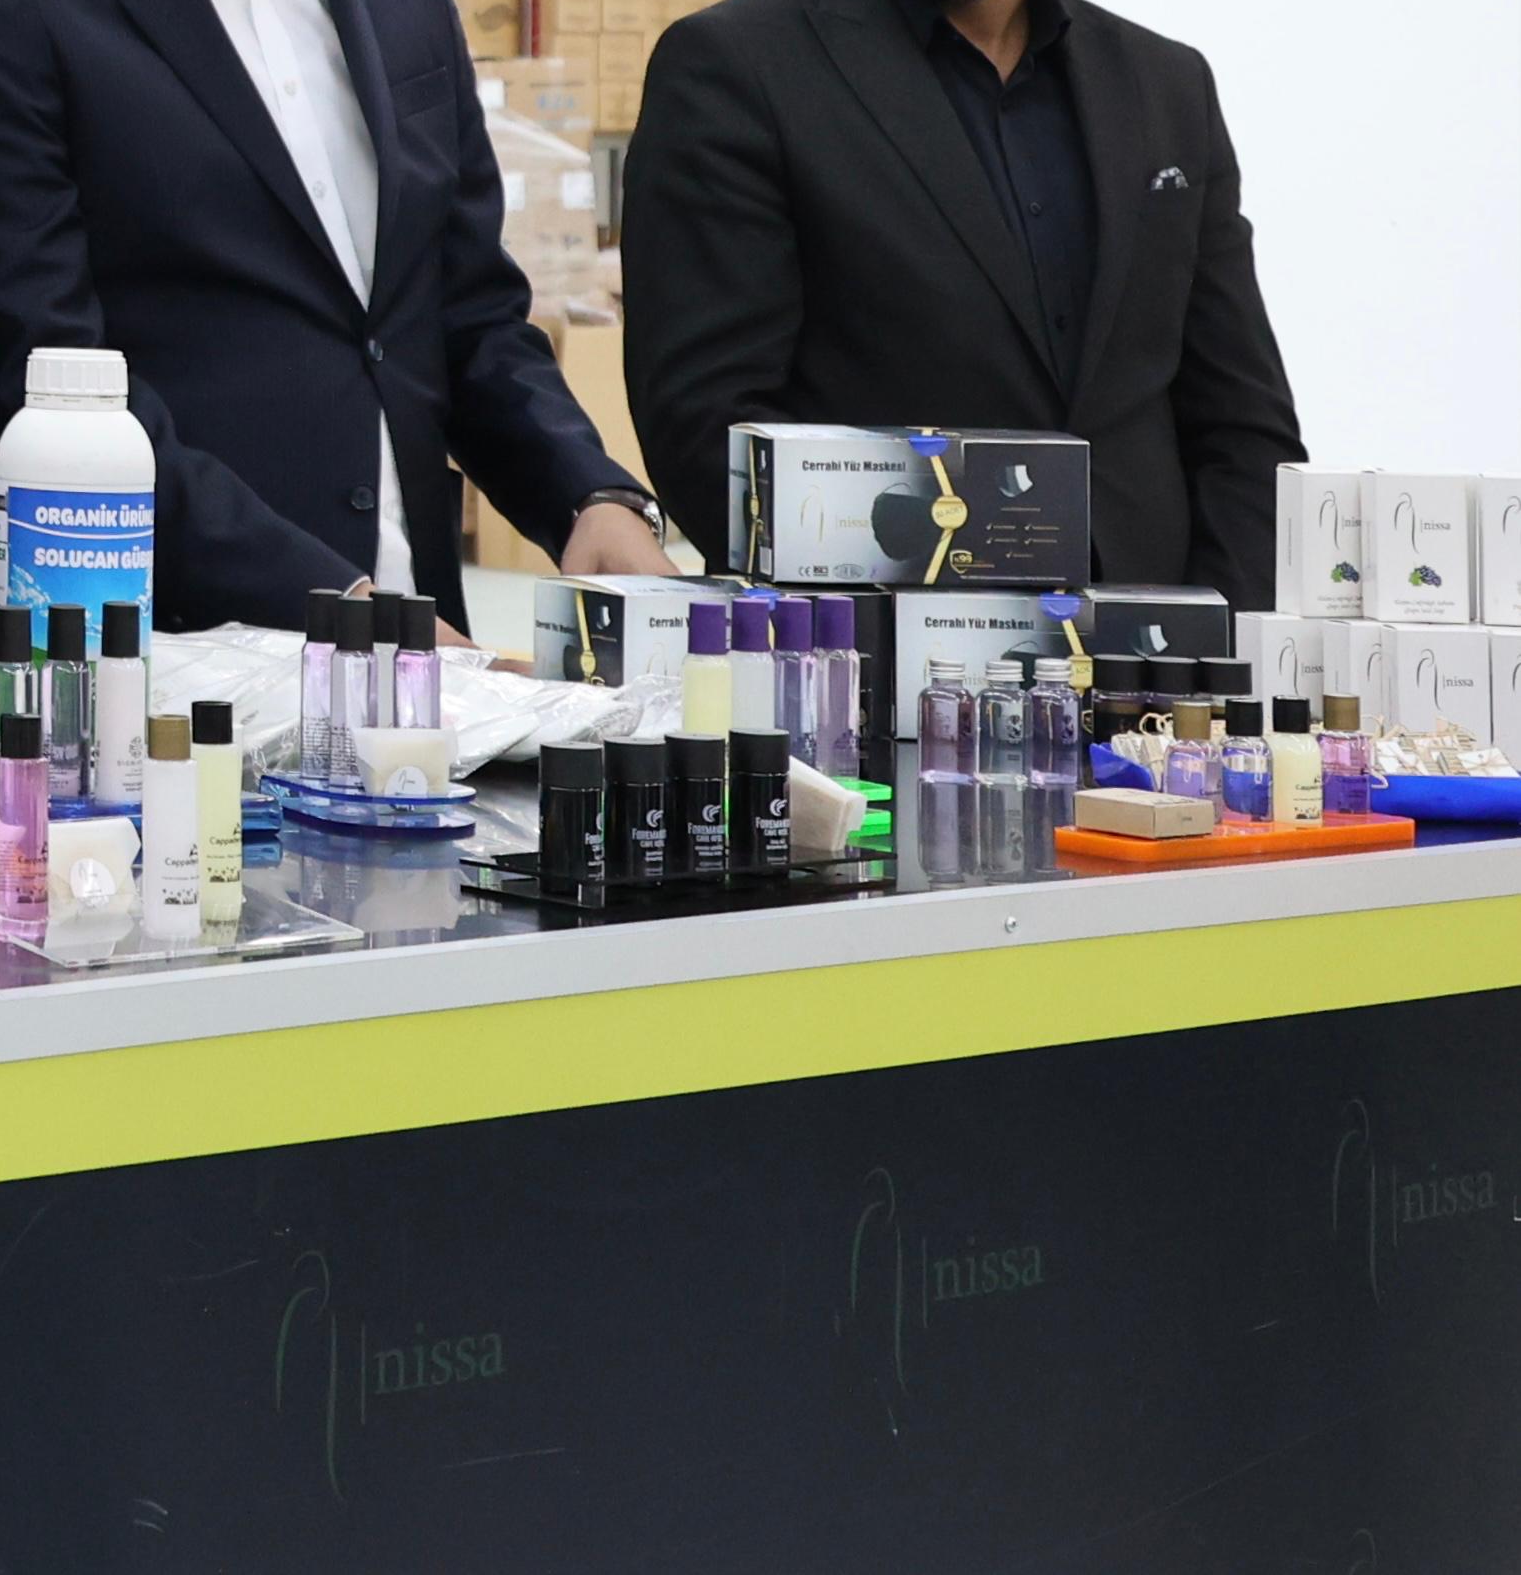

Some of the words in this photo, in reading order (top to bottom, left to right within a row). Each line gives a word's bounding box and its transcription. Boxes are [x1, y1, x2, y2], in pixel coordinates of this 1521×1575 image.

[801, 460, 842, 472] Cerrahi
[844, 460, 861, 472] Yüz
[863, 461, 906, 473] Maskesi
[35, 504, 118, 527] ORGANİK
[119, 504, 154, 527] ÜRÜN
[1423, 518, 1452, 530] nissa
[34, 547, 119, 570] SOLUCAN
[121, 546, 154, 569] GÜB
[649, 617, 683, 629] Cerrahi
[925, 617, 966, 630] Cerrahi
[968, 617, 986, 630] Yüz
[989, 618, 1034, 631] Maskesi
[1446, 676, 1474, 688] nissa
[1401, 1164, 1495, 1224] nissa
[931, 1236, 1045, 1301] nissa
[372, 1323, 507, 1396] nissa
